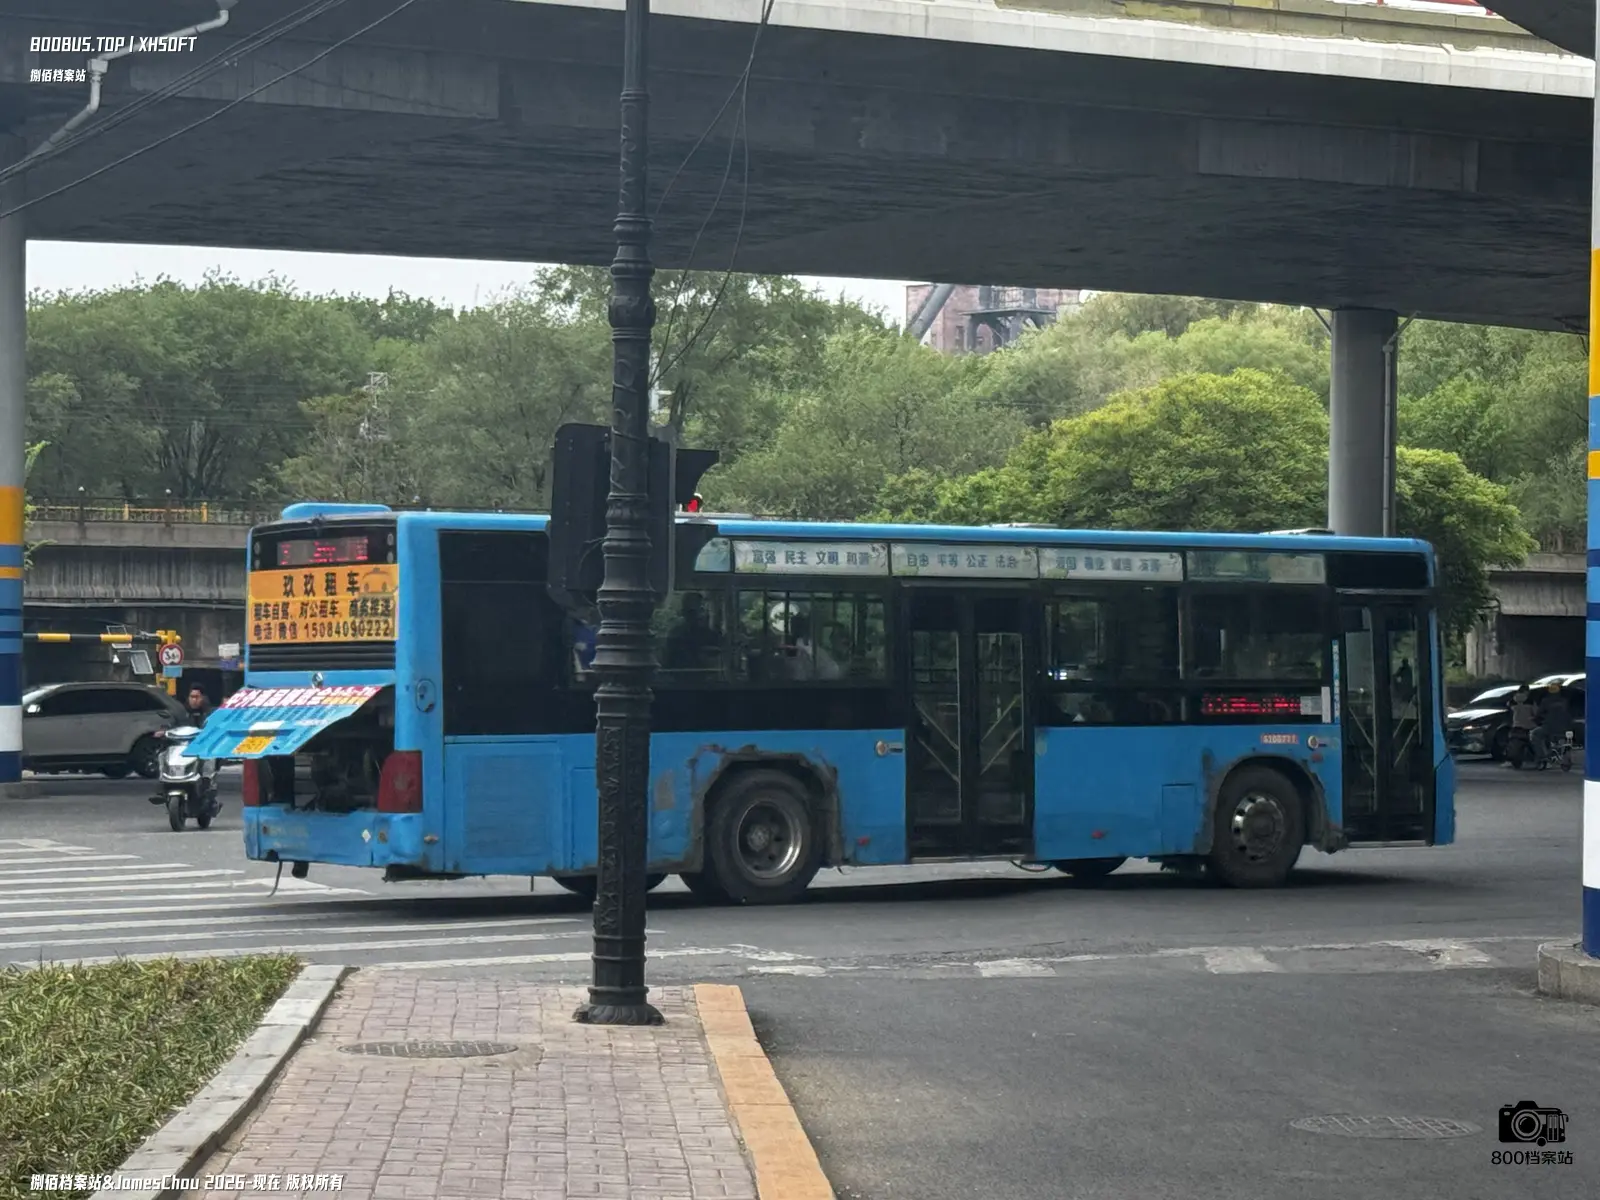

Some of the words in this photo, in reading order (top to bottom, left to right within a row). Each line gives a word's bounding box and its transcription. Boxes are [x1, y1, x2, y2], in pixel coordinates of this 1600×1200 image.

[784, 551, 807, 565] 民主
[816, 551, 839, 565] 文明
[907, 553, 929, 567] 自由
[937, 553, 958, 567] 平等
[966, 554, 988, 568] 公正
[995, 555, 1017, 568] 法治
[283, 571, 360, 597] 玖玖租车
[304, 619, 390, 638] 15084090222
